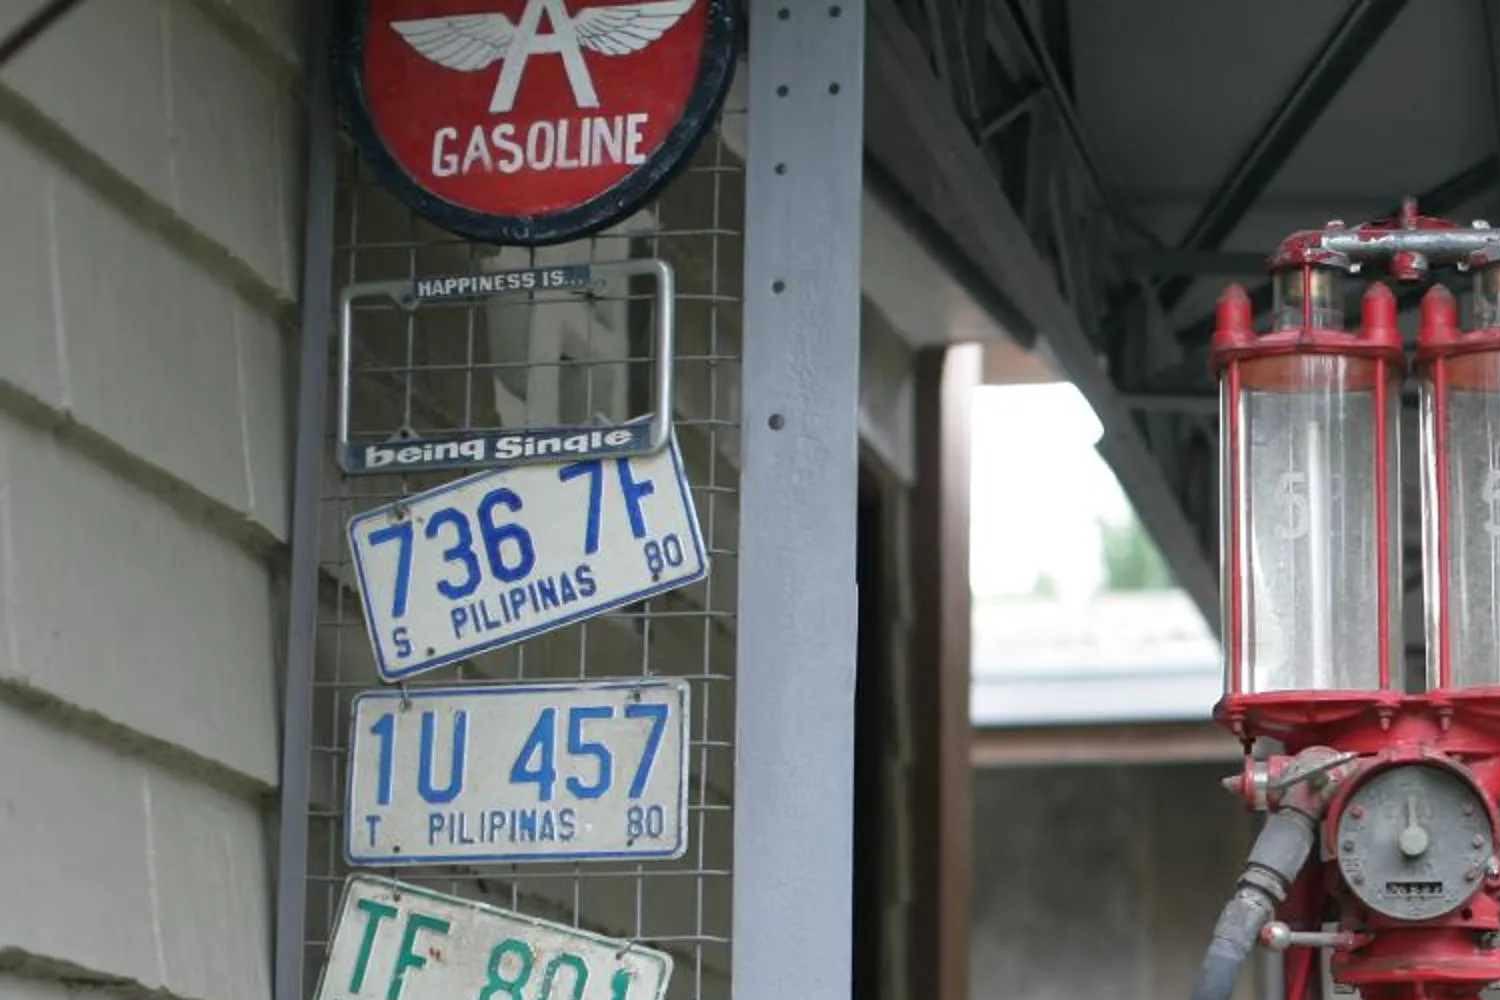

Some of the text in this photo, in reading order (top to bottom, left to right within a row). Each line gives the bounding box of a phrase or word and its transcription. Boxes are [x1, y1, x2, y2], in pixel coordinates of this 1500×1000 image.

[432, 113, 649, 177] GASOLINE
[418, 269, 585, 298] HAPPINESS IS...
[368, 487, 536, 619] 736
[392, 532, 684, 657] S PILIPINAS 80
[369, 704, 670, 806] 1U 457
[365, 805, 664, 847] T PILIPINAS 80
